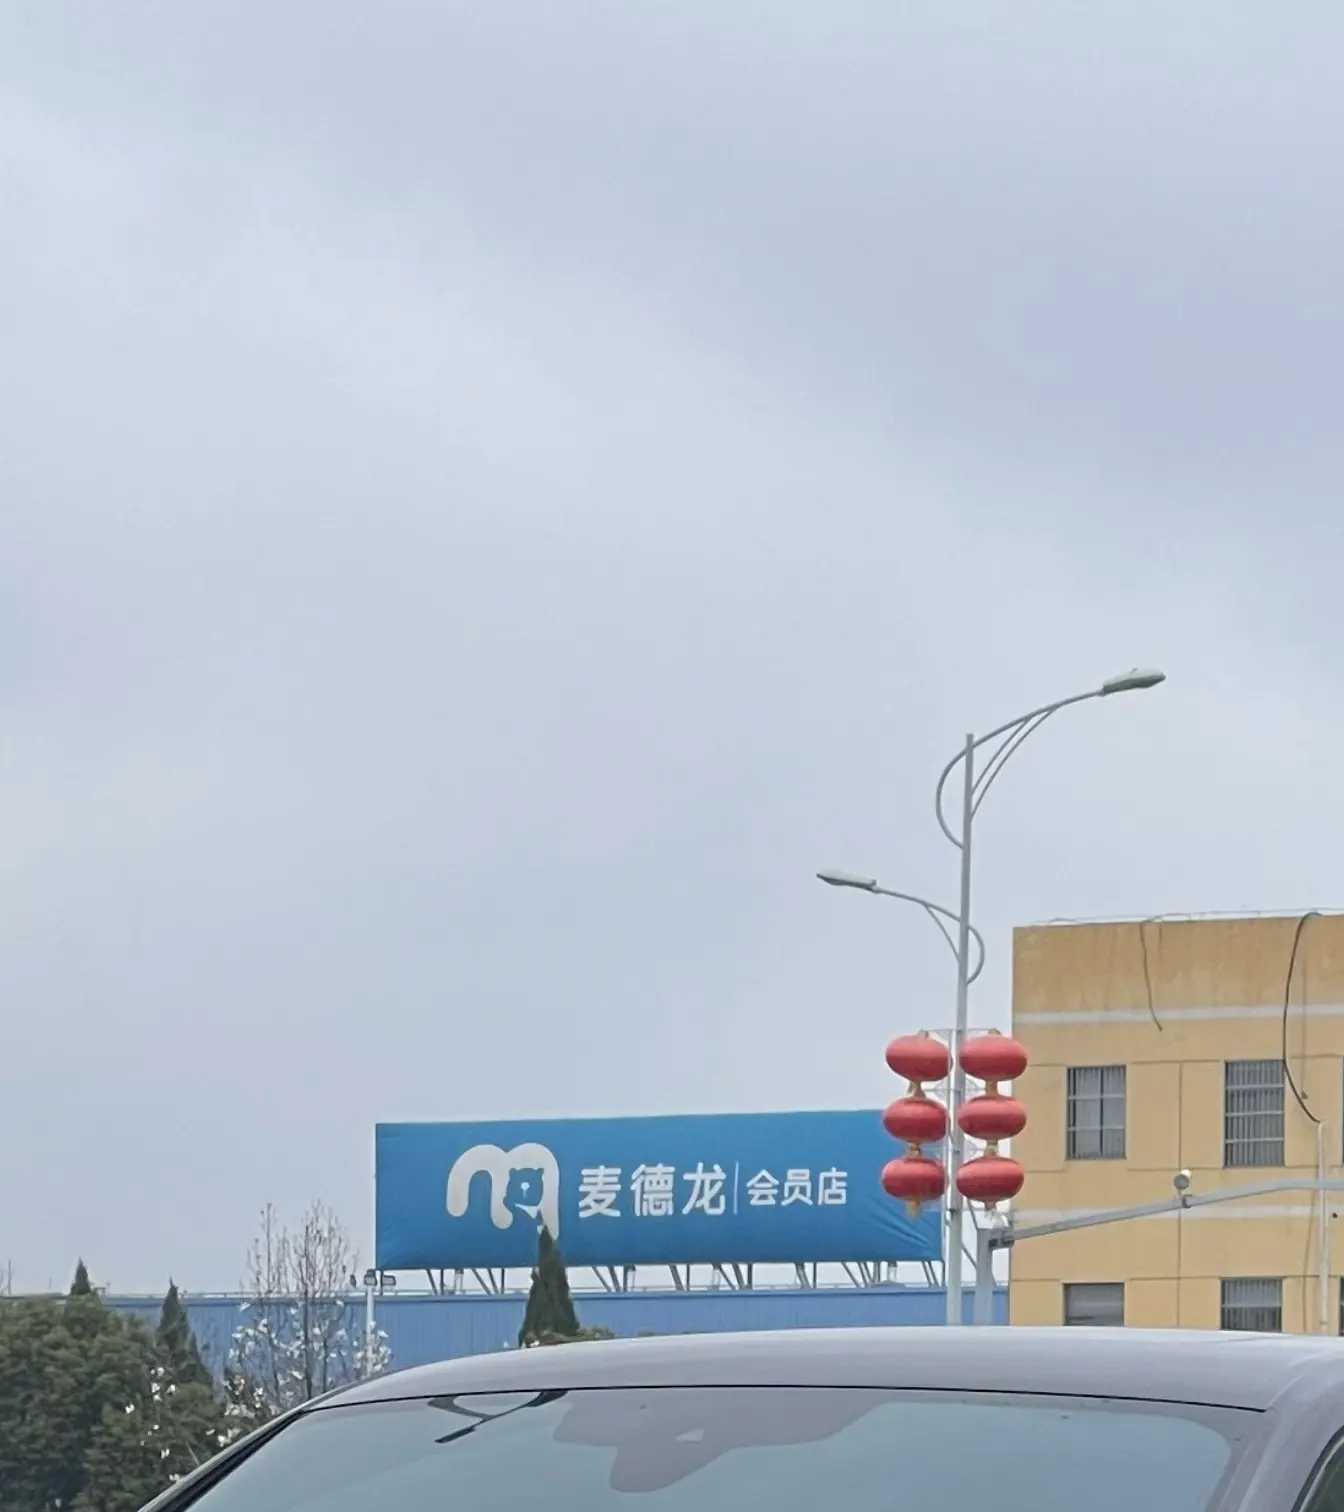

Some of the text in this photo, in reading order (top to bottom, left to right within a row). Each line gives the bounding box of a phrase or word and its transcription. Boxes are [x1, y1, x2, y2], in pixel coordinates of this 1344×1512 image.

[577, 1162, 849, 1219] 麦德龙 会员店
